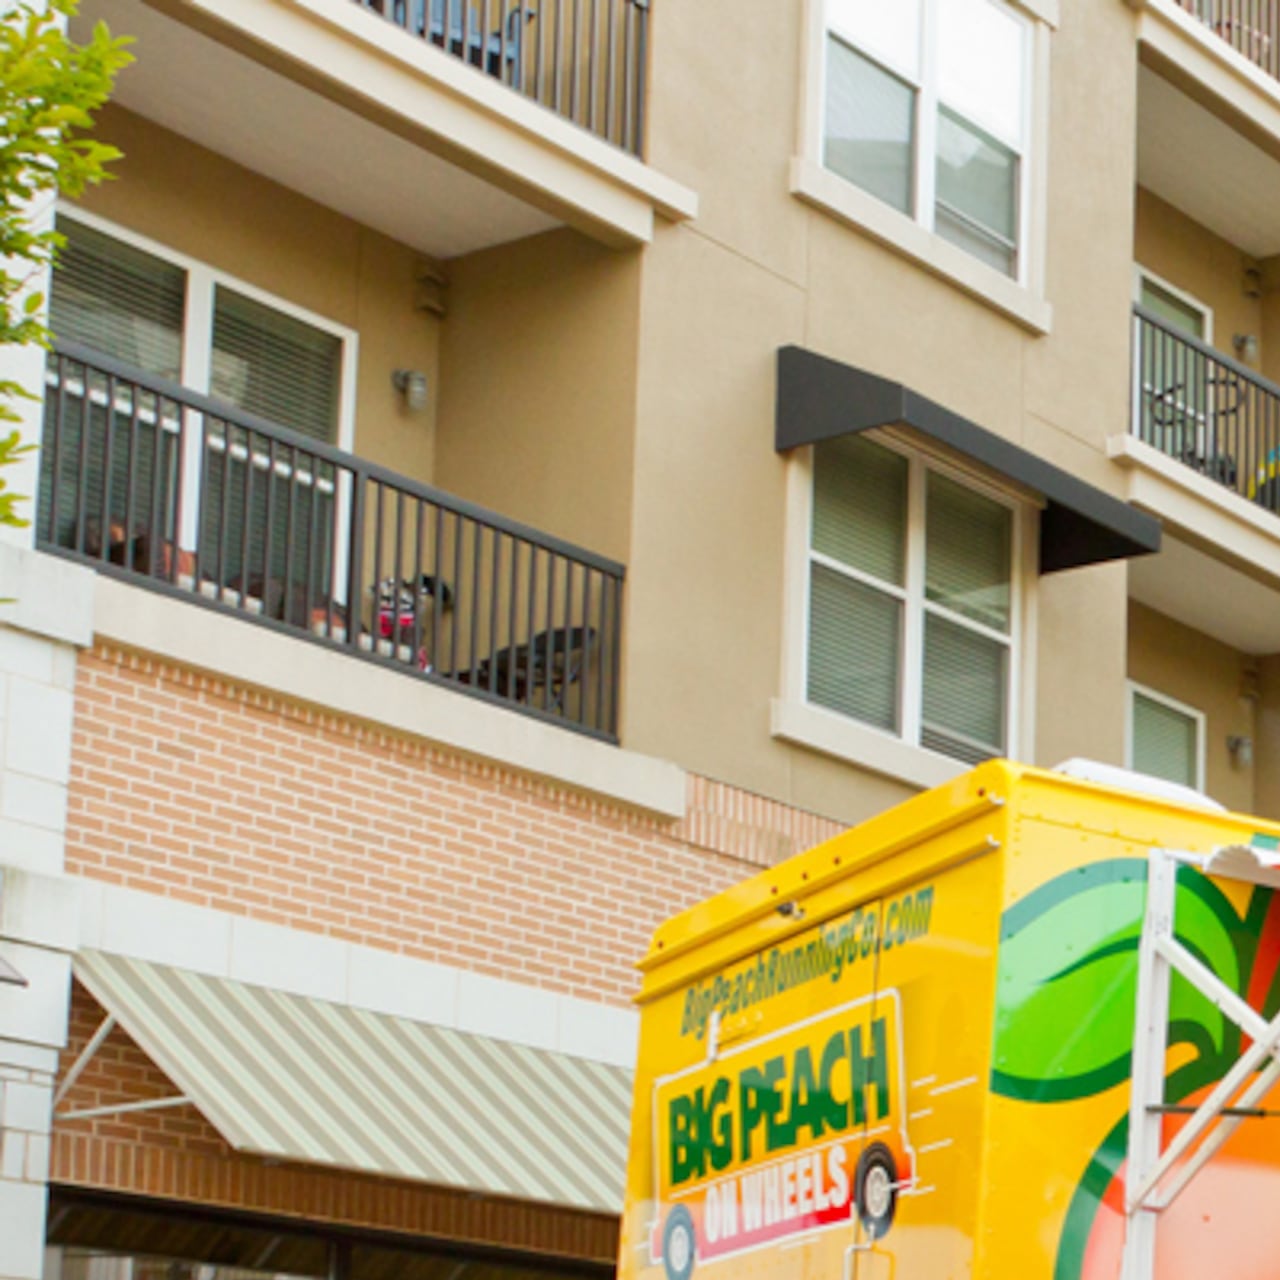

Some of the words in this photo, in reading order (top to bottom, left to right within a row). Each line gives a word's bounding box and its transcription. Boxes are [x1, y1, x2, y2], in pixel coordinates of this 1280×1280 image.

[669, 1076, 733, 1186] BIG
[740, 1018, 890, 1163] PEACH
[705, 1183, 739, 1243] ON
[741, 1144, 850, 1233] WHEELS
